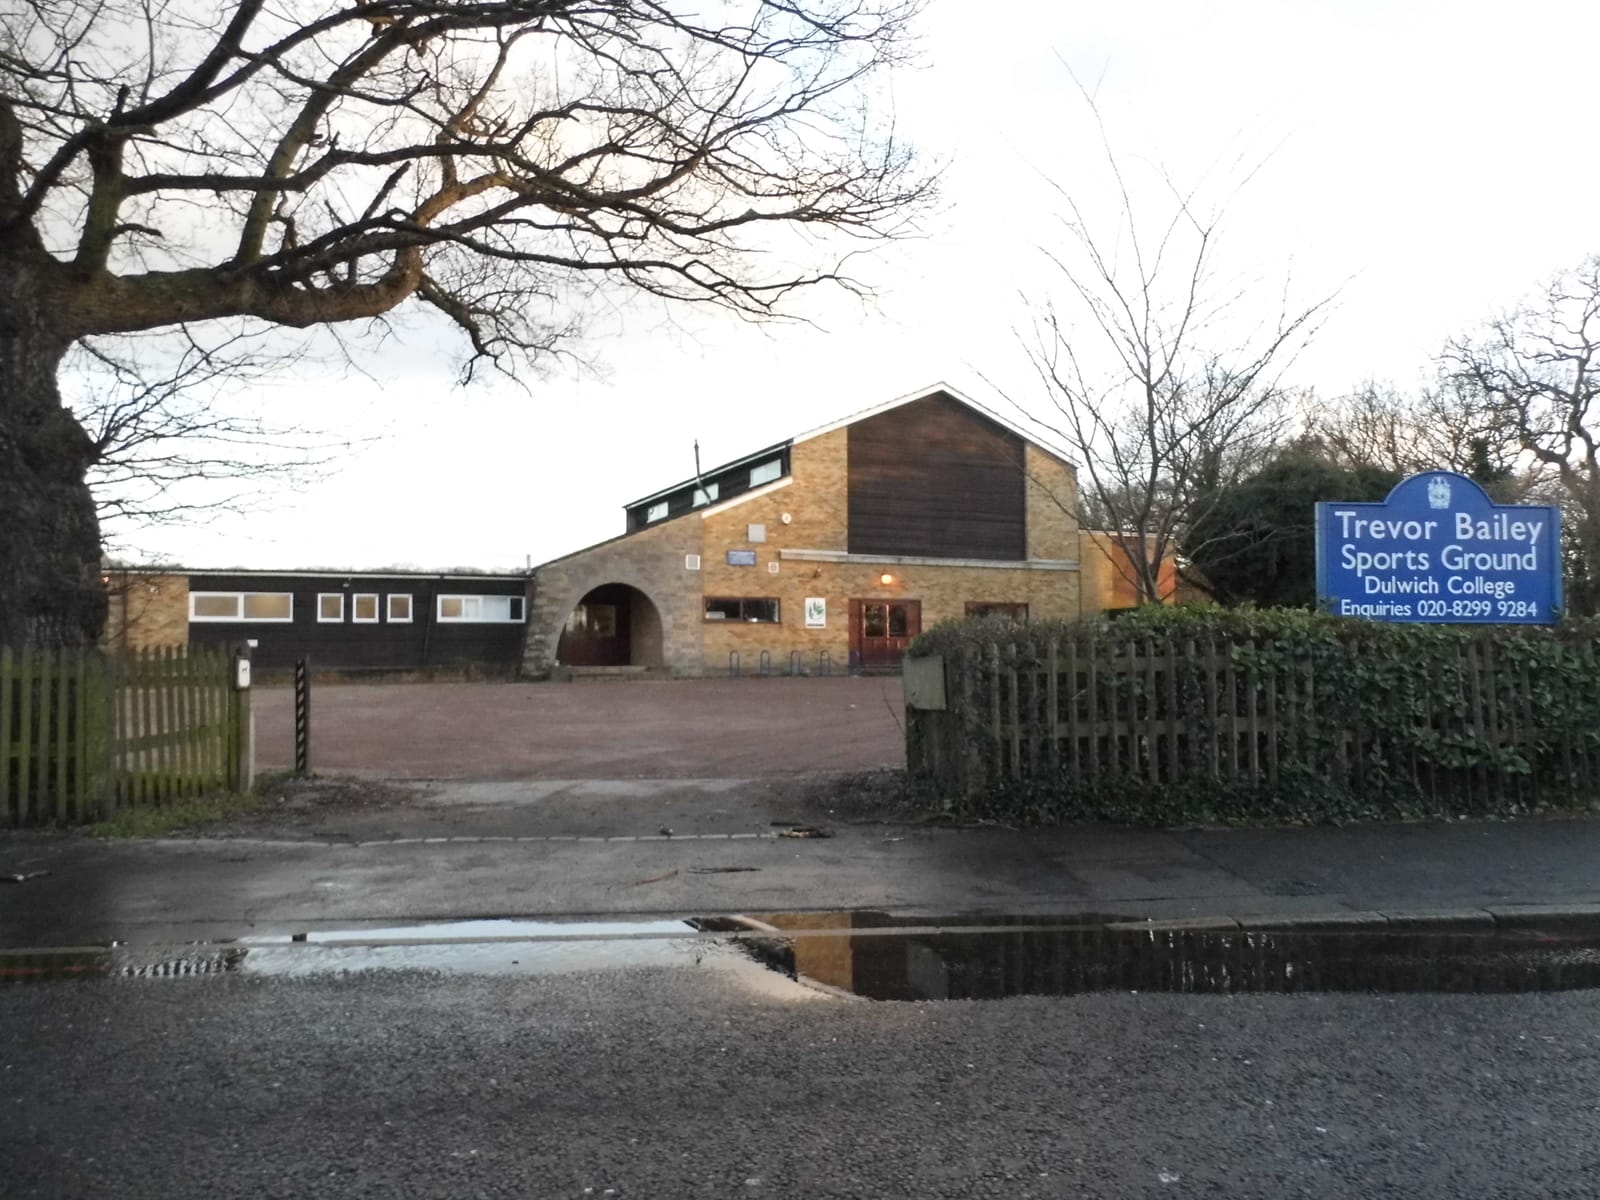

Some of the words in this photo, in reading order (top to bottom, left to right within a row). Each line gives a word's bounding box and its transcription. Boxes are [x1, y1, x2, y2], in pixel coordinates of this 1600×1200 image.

[1335, 511, 1437, 539] Trevor
[1455, 512, 1543, 544] Bailey
[1341, 544, 1429, 577] Sports
[1441, 545, 1537, 570] Ground
[1365, 576, 1439, 594] Dulwich
[1448, 576, 1515, 599] College
[1341, 600, 1411, 616] Enquiries
[1417, 600, 1491, 616] 020-8299
[1498, 601, 1537, 617] 9284
